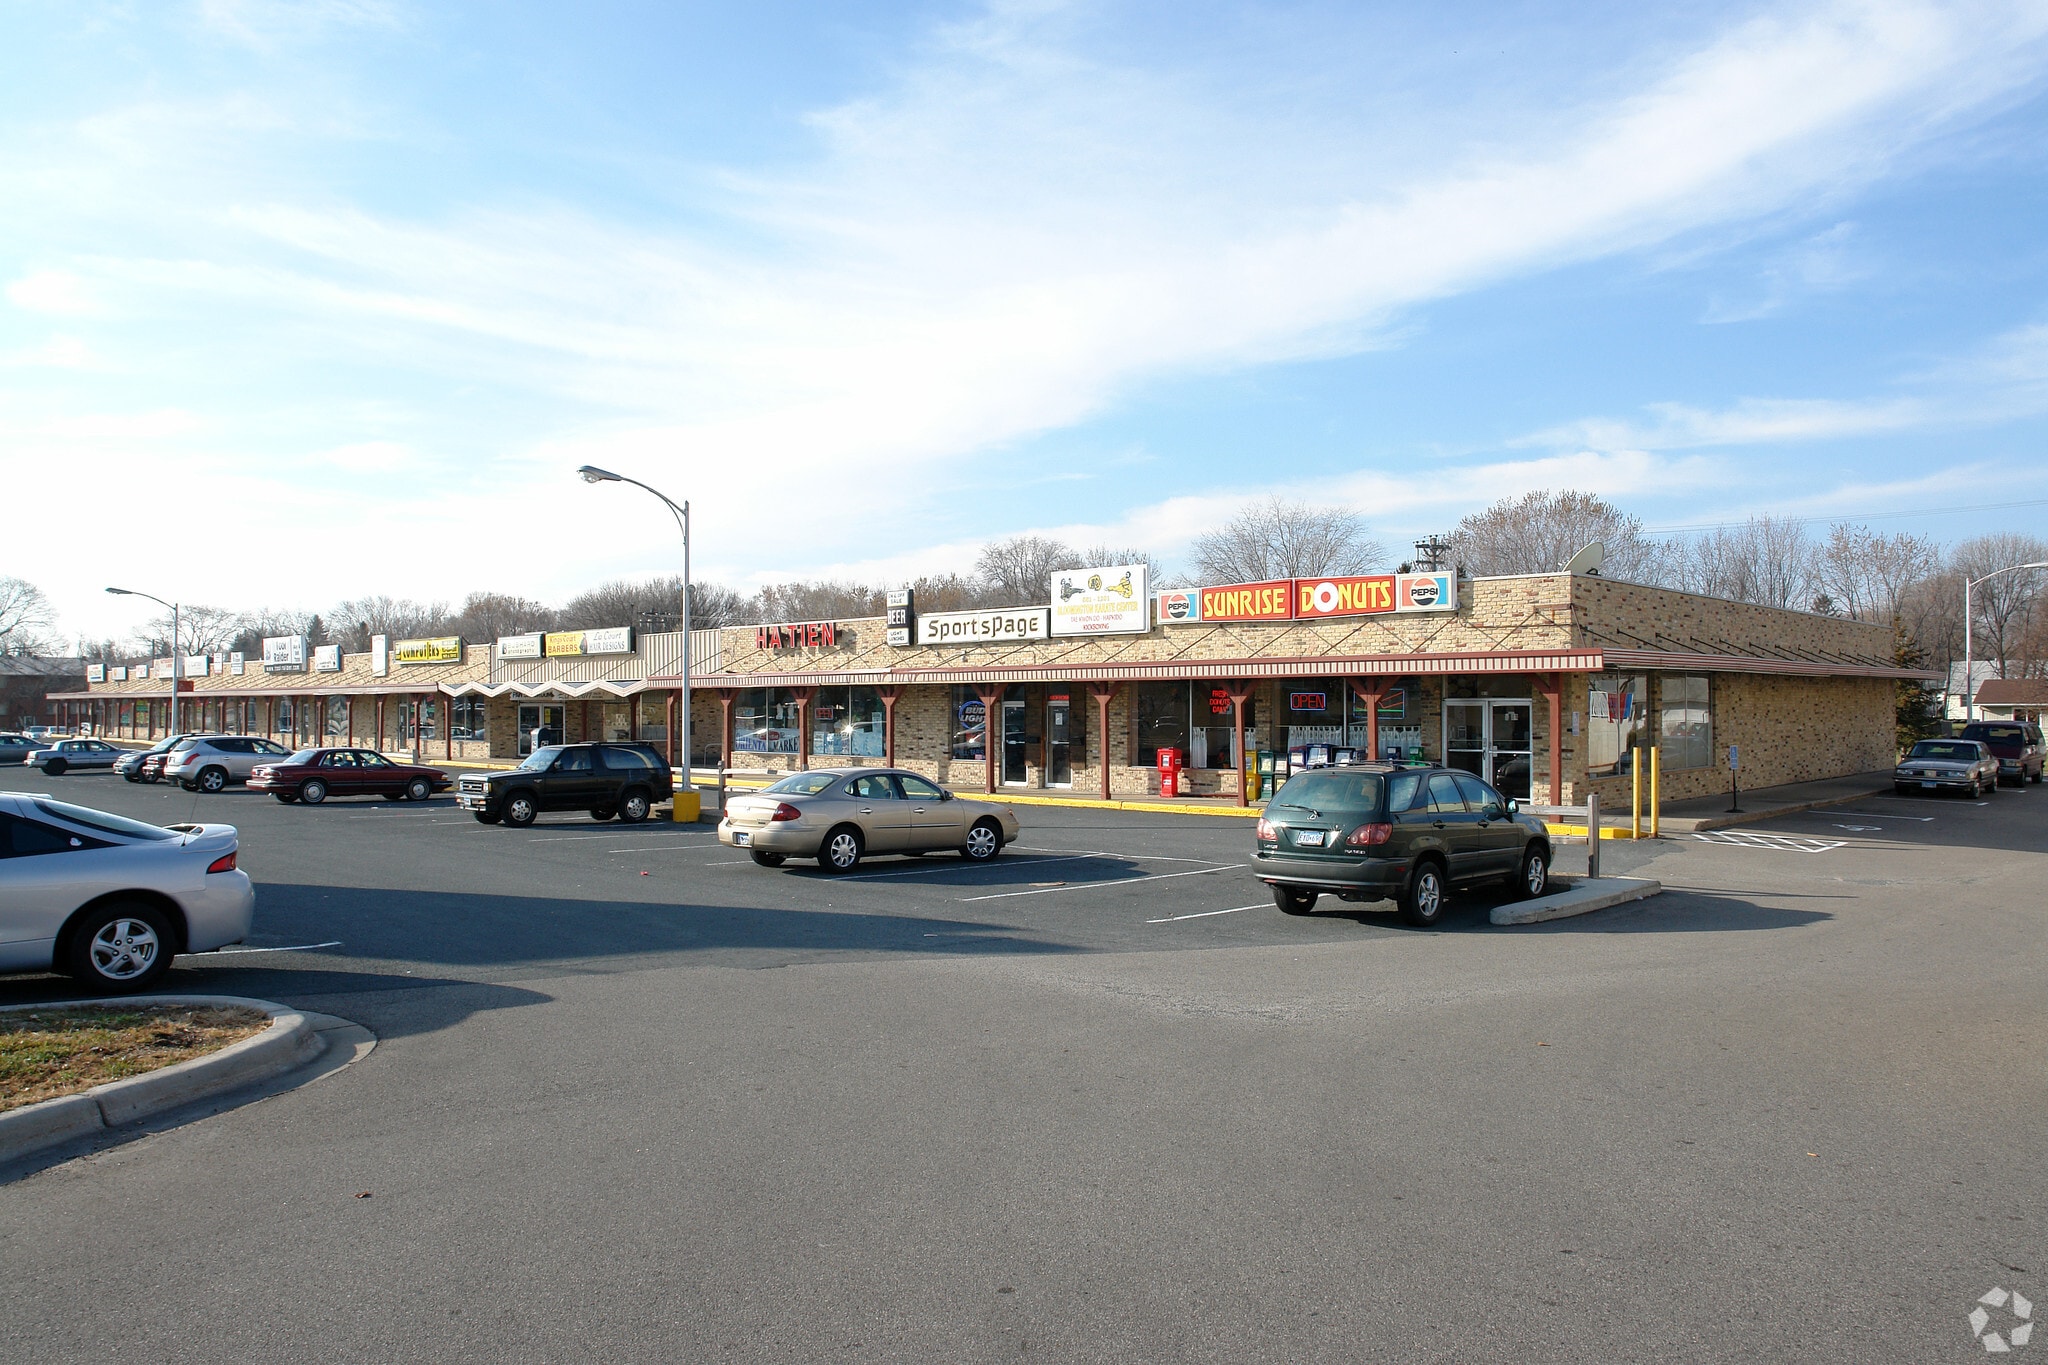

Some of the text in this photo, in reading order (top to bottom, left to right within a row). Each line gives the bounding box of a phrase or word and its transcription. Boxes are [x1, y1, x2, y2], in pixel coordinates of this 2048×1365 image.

[1411, 587, 1438, 597] PEPSI
[1203, 580, 1392, 618] SUNRISE DONUTS
[1094, 602, 1116, 613] KARATE
[1116, 601, 1138, 612] CENTER
[1168, 602, 1189, 610] PEPSI
[887, 609, 906, 625] BEER
[756, 622, 834, 649] HA TIEN
[547, 644, 578, 654] BARBERS
[602, 641, 625, 650] DESIGNS
[1292, 694, 1325, 709] OPEN
[965, 705, 986, 715] BUD
